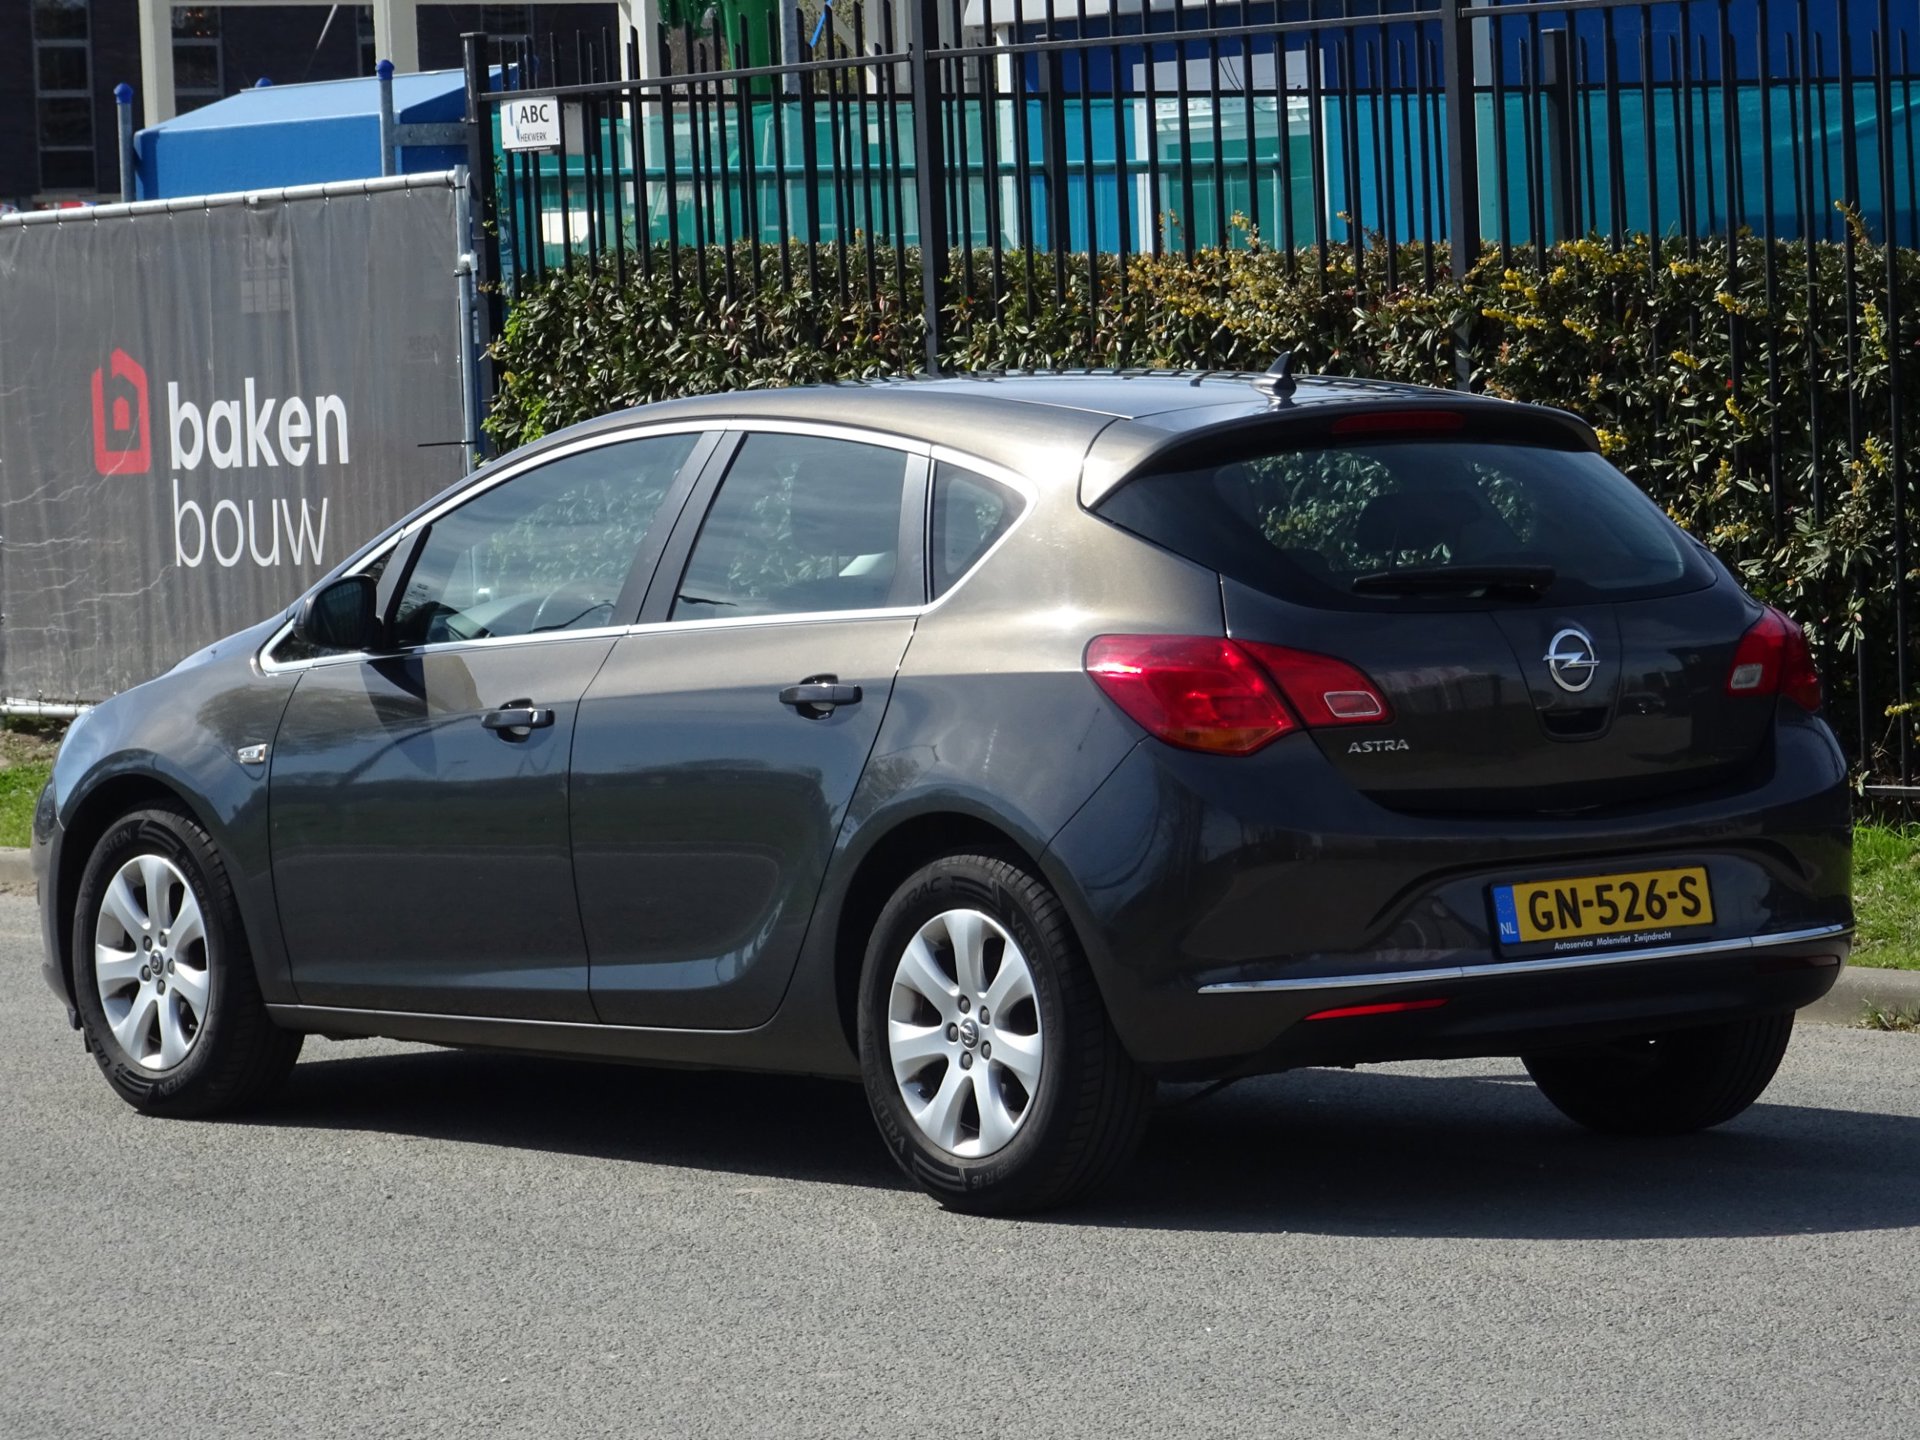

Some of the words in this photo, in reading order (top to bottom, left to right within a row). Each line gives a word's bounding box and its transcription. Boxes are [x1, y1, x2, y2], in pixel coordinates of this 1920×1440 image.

[520, 104, 549, 124] ABC
[520, 131, 547, 142] HEKWERK
[168, 377, 349, 470] baken
[173, 479, 328, 567] bouw
[1348, 739, 1410, 754] ASTRA
[1528, 875, 1702, 932] GN-526-S
[1500, 922, 1517, 936] NL
[1554, 939, 1594, 951] Autoservice
[1634, 931, 1672, 943] Zwijndrecht
